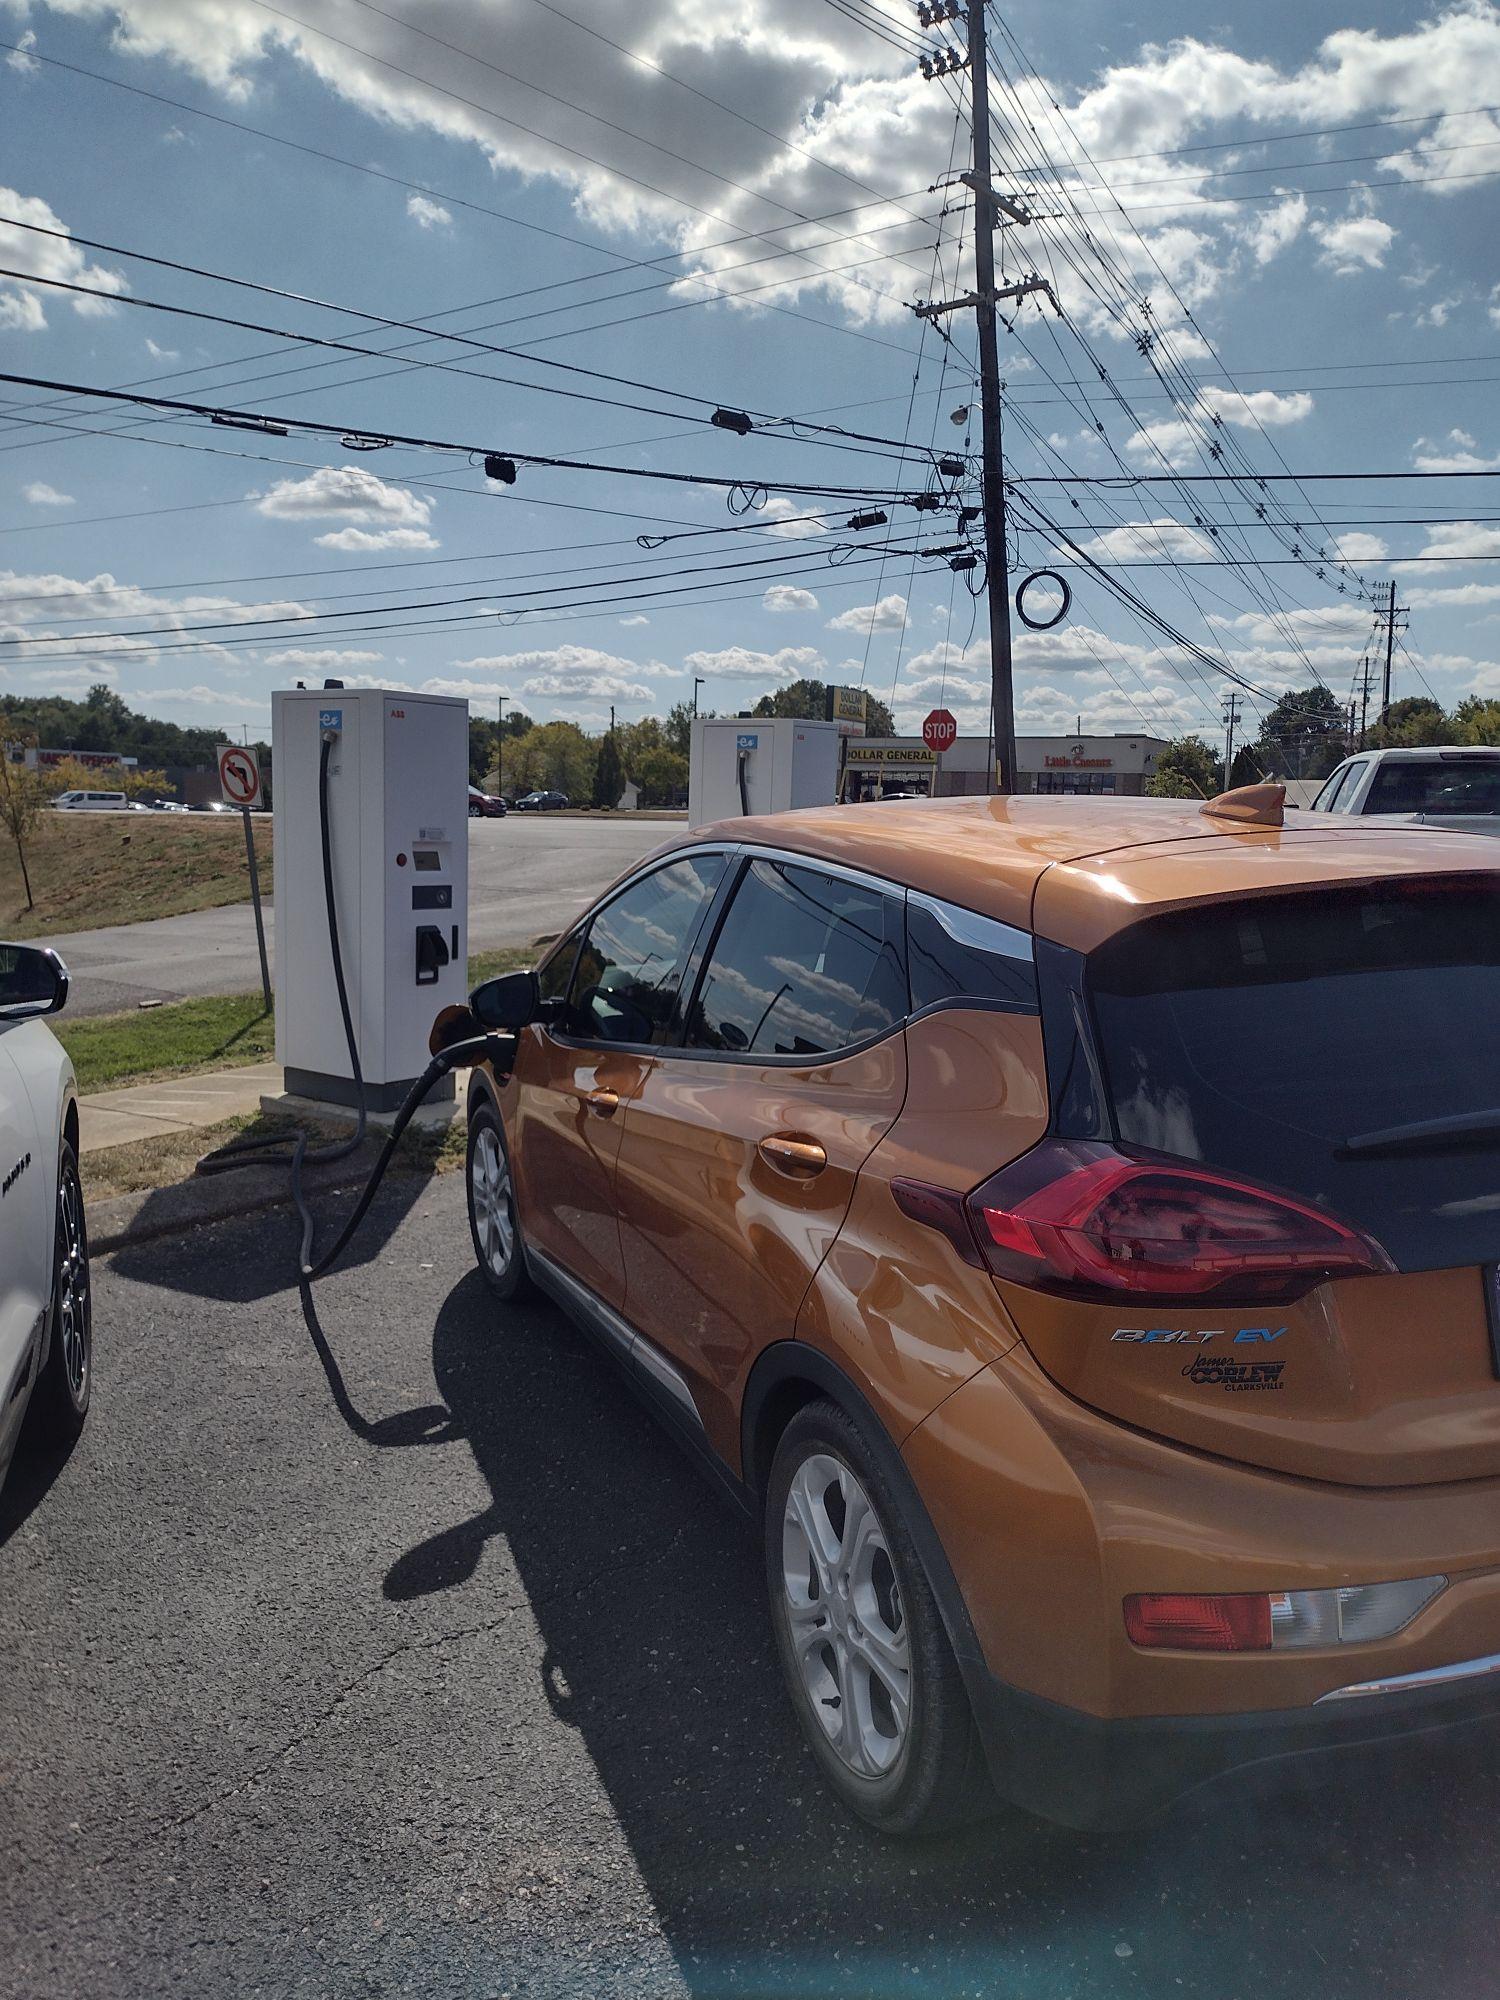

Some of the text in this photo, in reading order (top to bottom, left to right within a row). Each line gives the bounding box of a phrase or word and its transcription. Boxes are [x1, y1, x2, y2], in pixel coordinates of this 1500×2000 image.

[923, 724, 954, 739] STOP
[887, 750, 934, 761] GENERAL
[1111, 1327, 1288, 1344] BOLT EV
[1181, 1353, 1236, 1377] James
[1224, 1383, 1284, 1392] CLARKSVILLE
